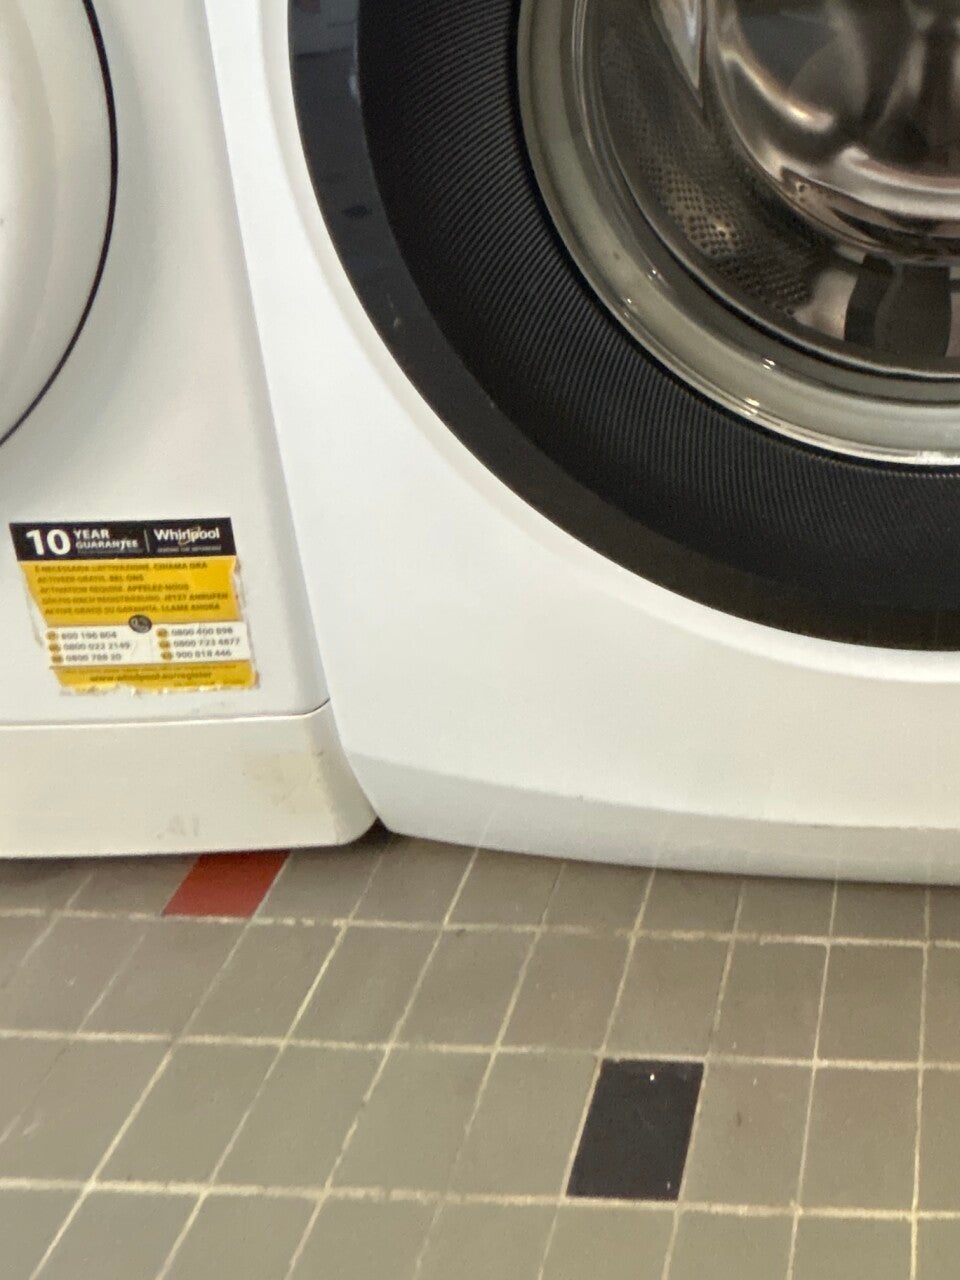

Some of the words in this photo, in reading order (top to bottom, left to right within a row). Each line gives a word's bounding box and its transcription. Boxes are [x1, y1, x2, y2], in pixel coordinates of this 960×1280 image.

[73, 528, 110, 539] YEAR
[153, 526, 220, 543] Whirlpool
[26, 528, 71, 556] 10
[75, 539, 139, 550] GUARANTEE
